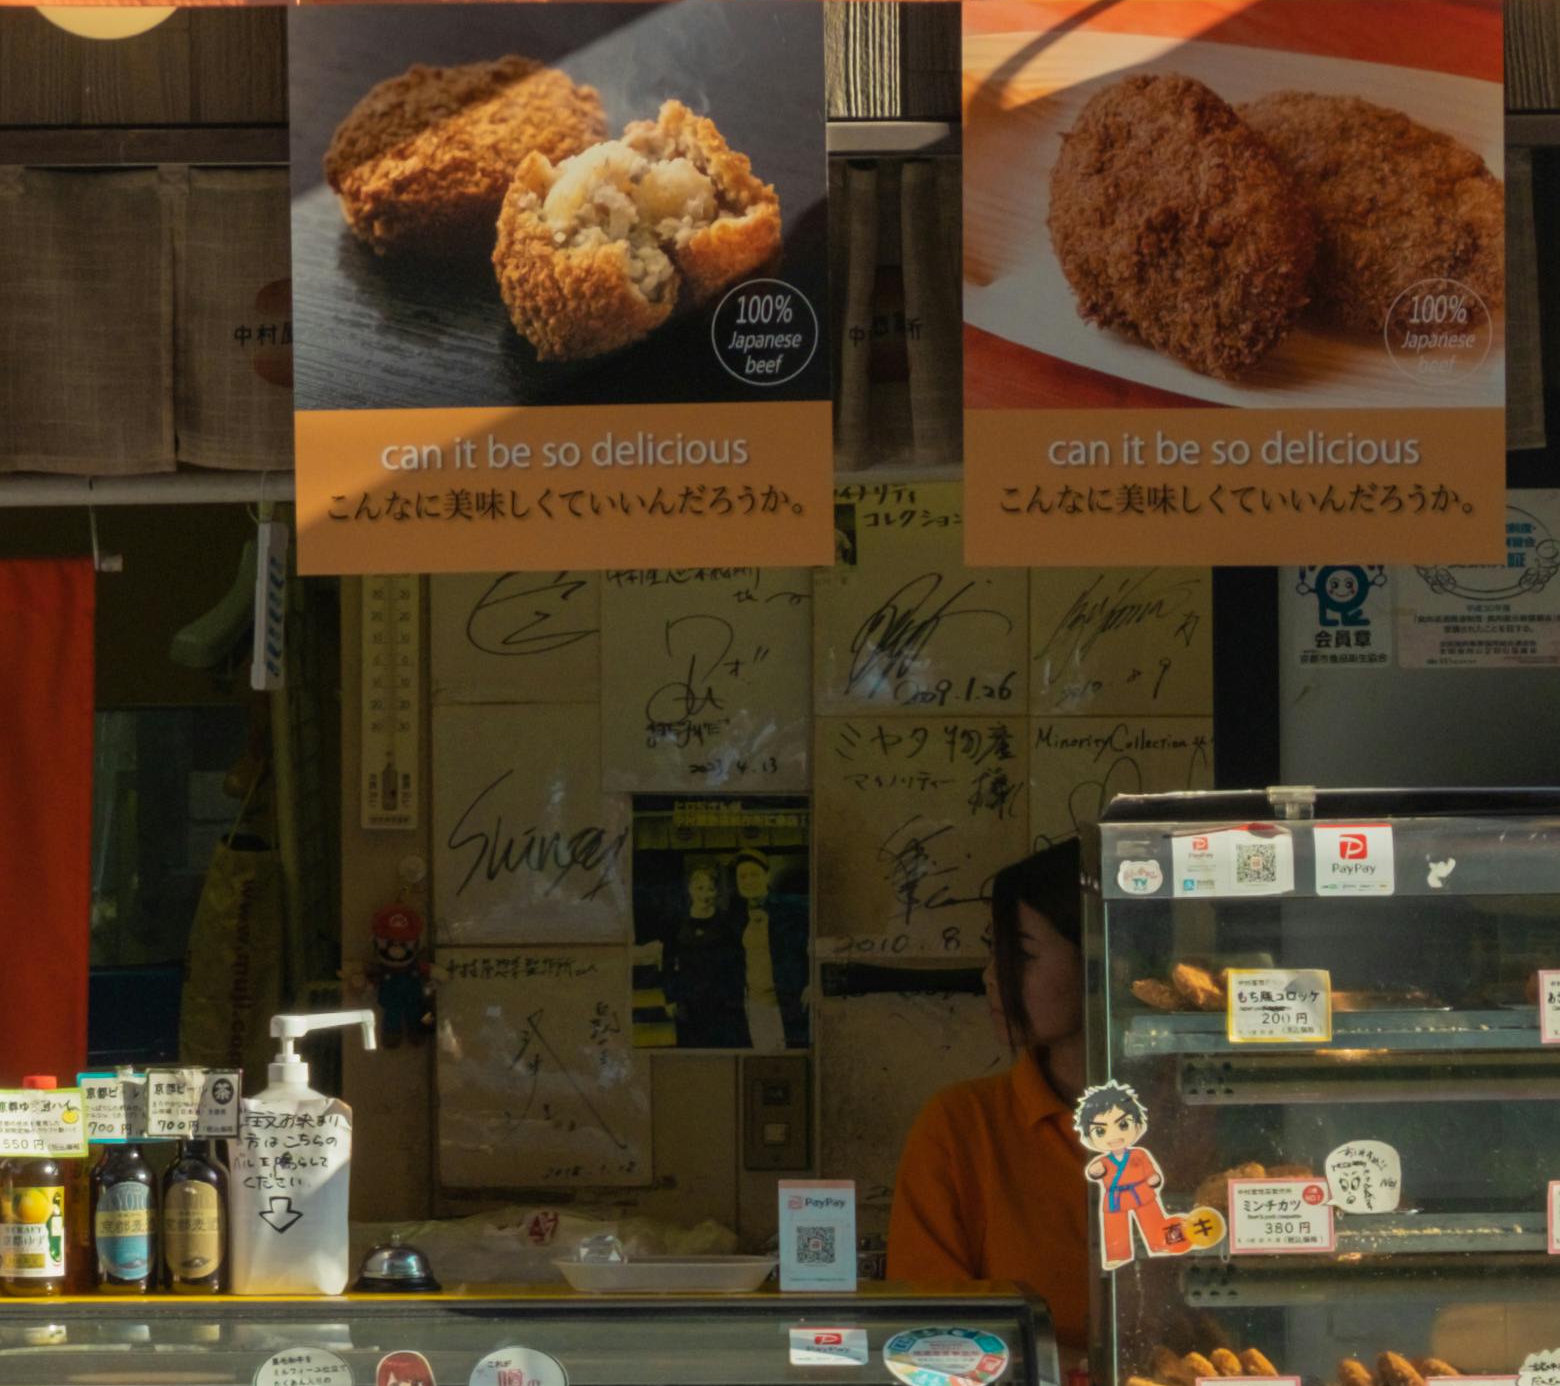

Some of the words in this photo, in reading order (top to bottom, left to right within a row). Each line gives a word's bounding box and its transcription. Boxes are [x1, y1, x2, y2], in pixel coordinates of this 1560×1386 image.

[735, 294, 793, 325] 100%
[1407, 294, 1468, 326] 100%
[727, 330, 802, 353] Japanese
[1400, 330, 1477, 352] Japanese
[744, 354, 783, 376] beef
[1417, 352, 1455, 374] beef
[380, 440, 442, 472] can
[454, 435, 477, 470] it
[486, 434, 532, 469] be
[541, 441, 582, 469] so
[591, 430, 749, 467] delicious
[1047, 436, 1111, 468] can
[1121, 431, 1144, 466] it
[1155, 431, 1201, 467] be
[1213, 438, 1252, 467] so
[1260, 430, 1421, 467] delicious
[328, 484, 806, 522] こんなに美味しくていいんだろうか。
[998, 483, 1477, 515] こんなに美味しくていいんだろうか。
[1314, 629, 1373, 649] 会員章
[1331, 860, 1377, 877] PayPay
[805, 1196, 847, 1209] PayPay
[1243, 1198, 1302, 1213] ミンチカツ
[1264, 1220, 1312, 1235] 380円
